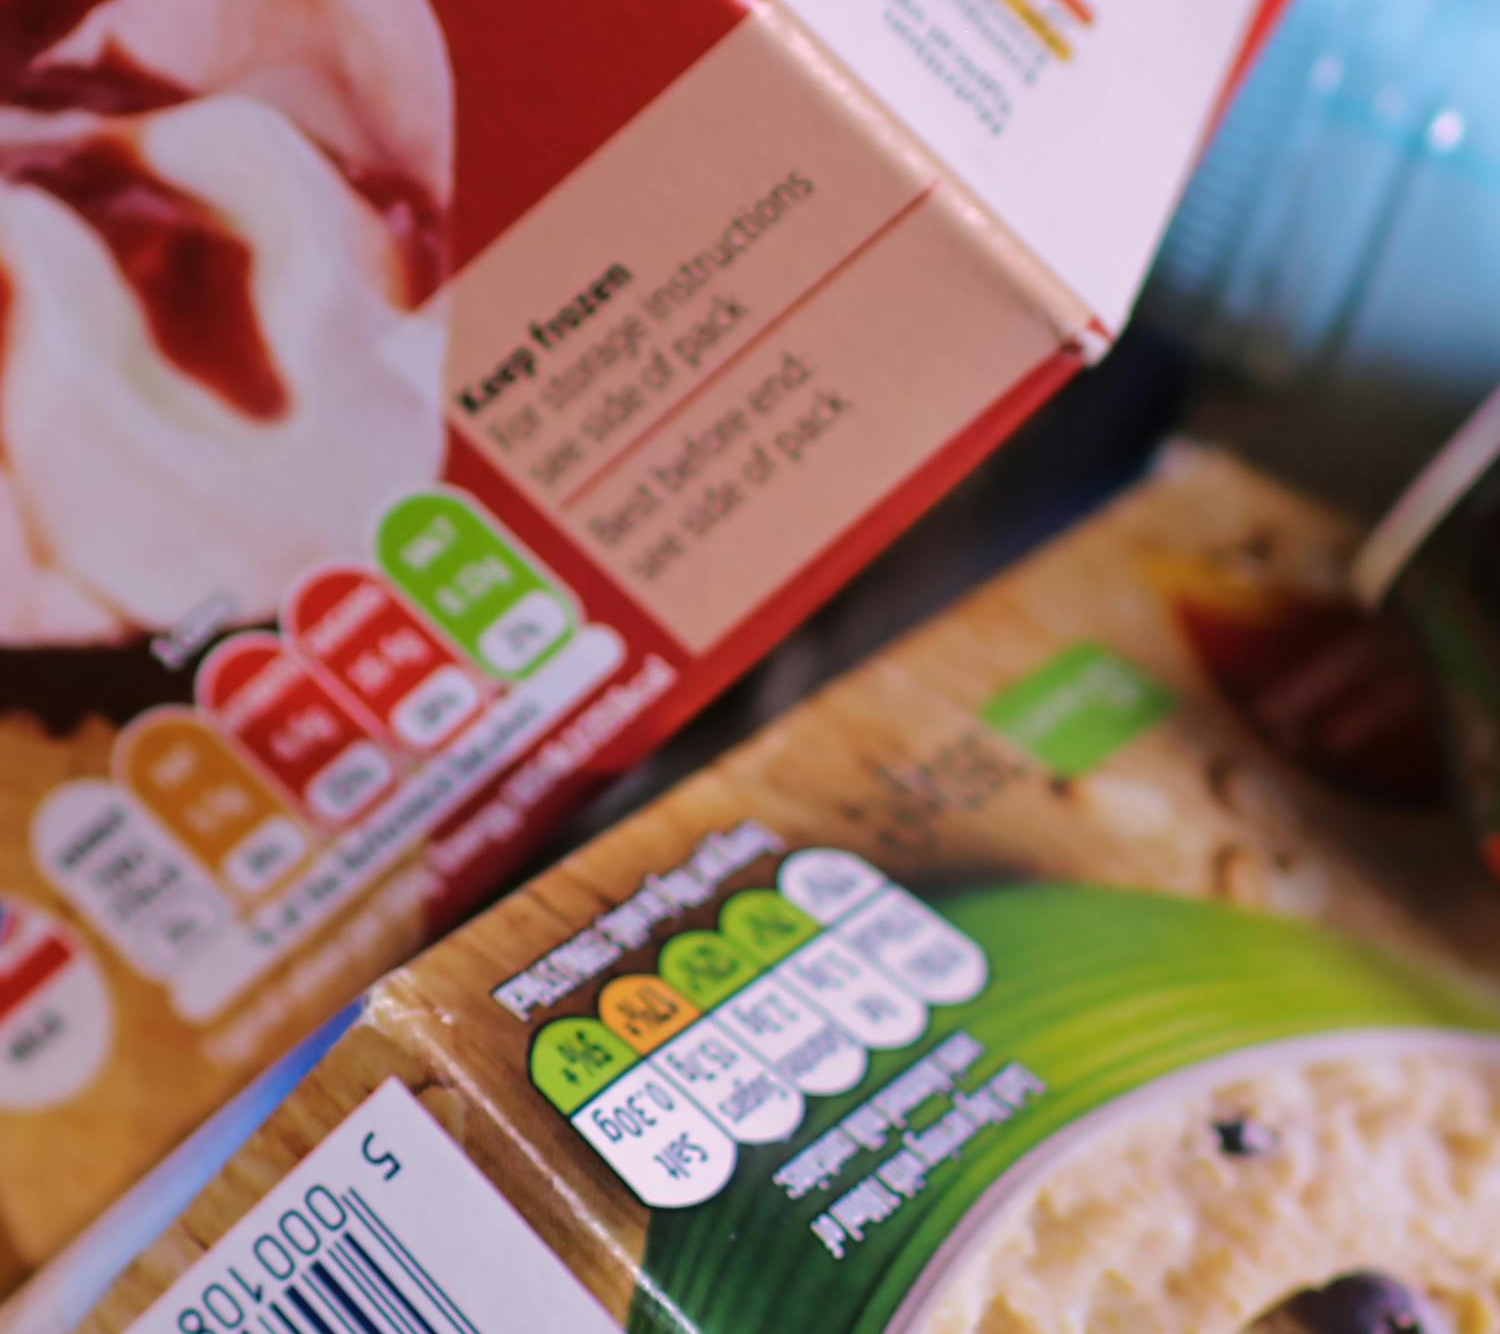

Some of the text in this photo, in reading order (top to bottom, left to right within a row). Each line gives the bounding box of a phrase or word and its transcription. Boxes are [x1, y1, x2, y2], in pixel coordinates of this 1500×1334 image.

[640, 168, 816, 323] instructions
[456, 259, 633, 418] Keep frozen
[591, 1068, 675, 1146] 0.30g
[360, 1133, 404, 1183] 5
[652, 1129, 709, 1182] Salt
